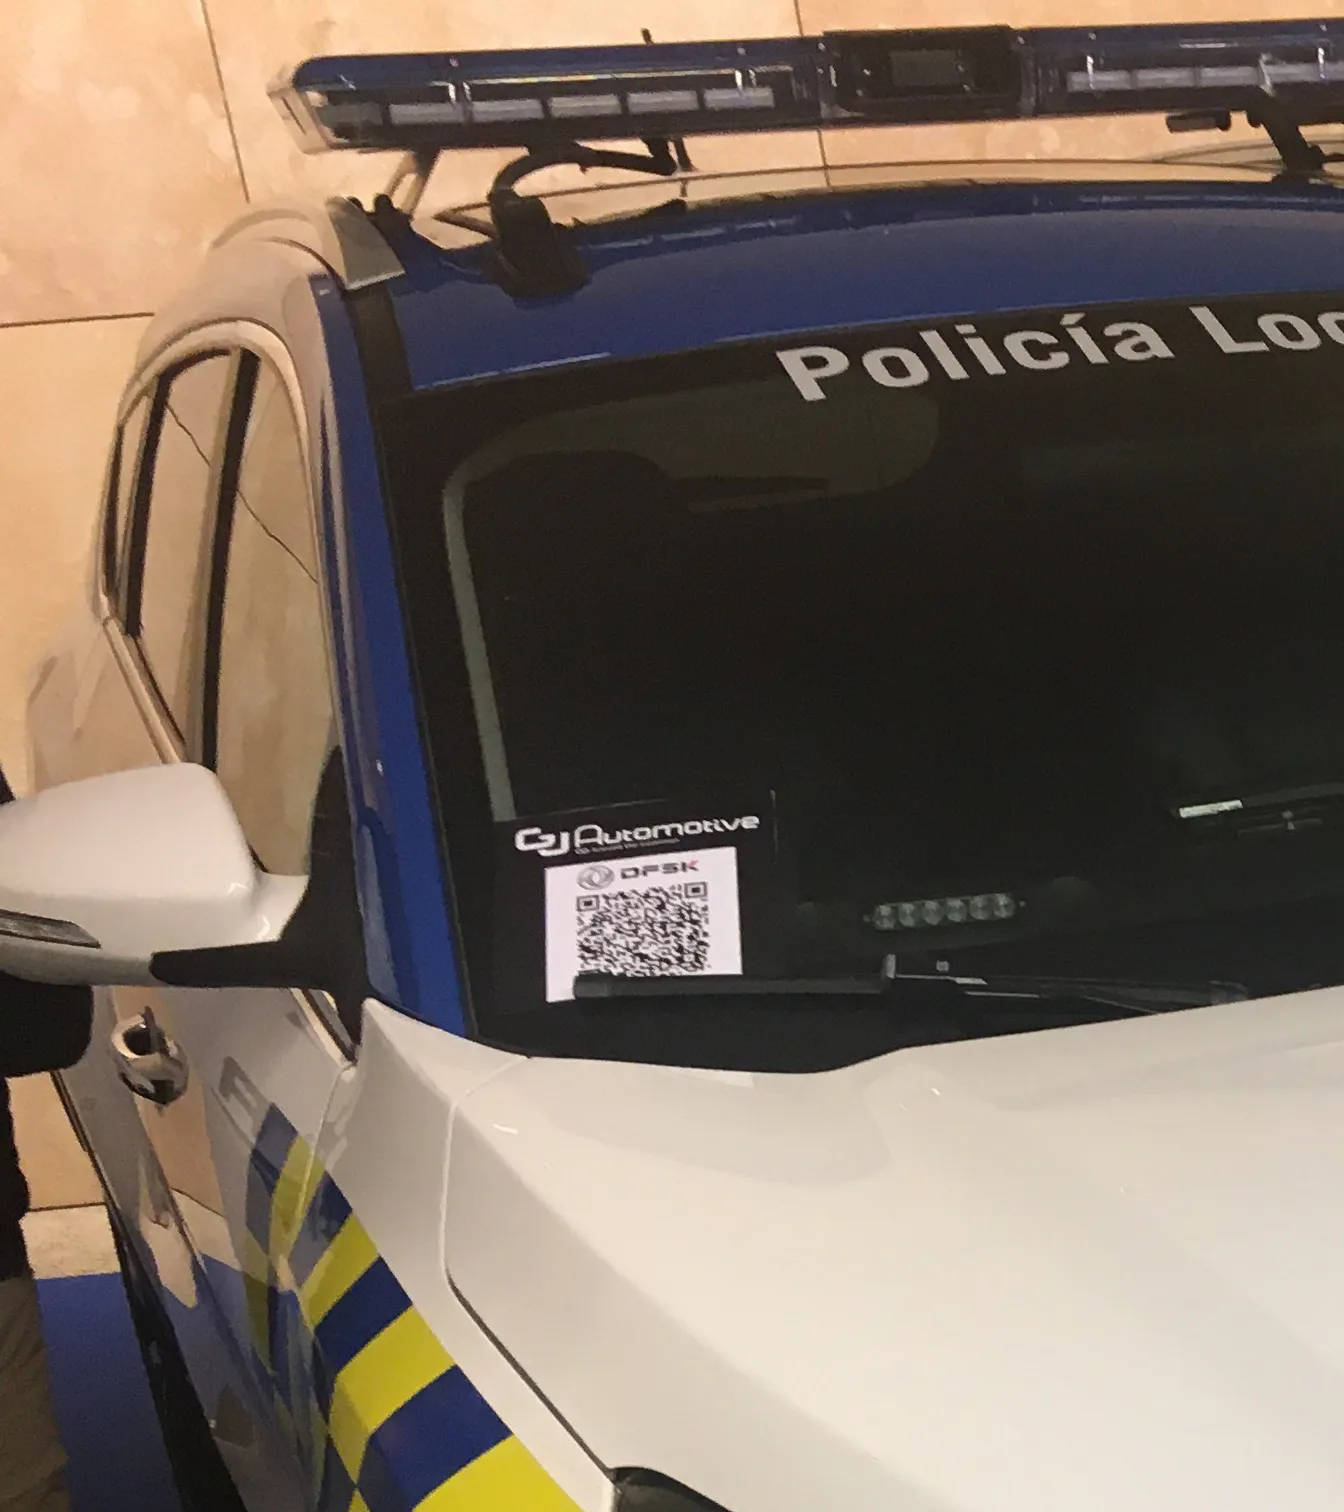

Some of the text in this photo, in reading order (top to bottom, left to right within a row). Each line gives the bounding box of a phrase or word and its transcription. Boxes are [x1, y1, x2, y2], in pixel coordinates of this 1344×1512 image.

[776, 312, 1175, 400] Policía
[574, 815, 760, 848] Automotive
[620, 860, 698, 879] DFSK
